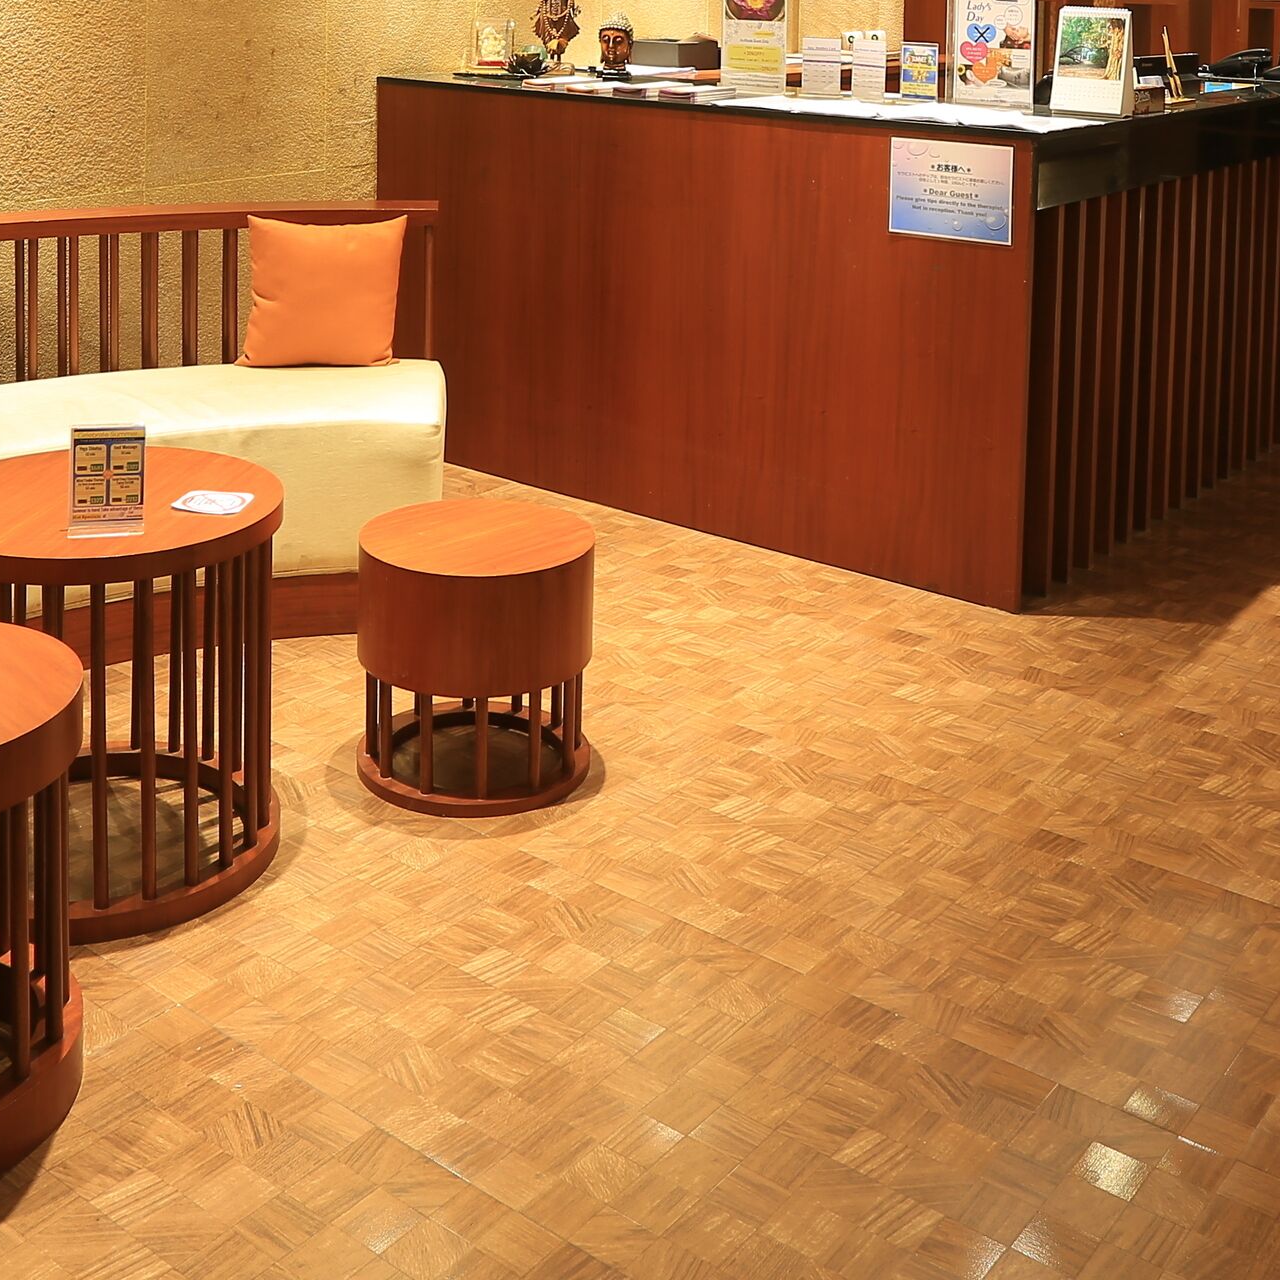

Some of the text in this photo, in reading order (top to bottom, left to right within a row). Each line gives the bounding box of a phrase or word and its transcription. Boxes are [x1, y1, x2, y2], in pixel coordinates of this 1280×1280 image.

[966, 0, 991, 11] Lady's
[966, 11, 984, 23] Day
[936, 164, 965, 173] お客様へ
[929, 188, 973, 199] Dear Guest
[939, 199, 959, 207] directly
